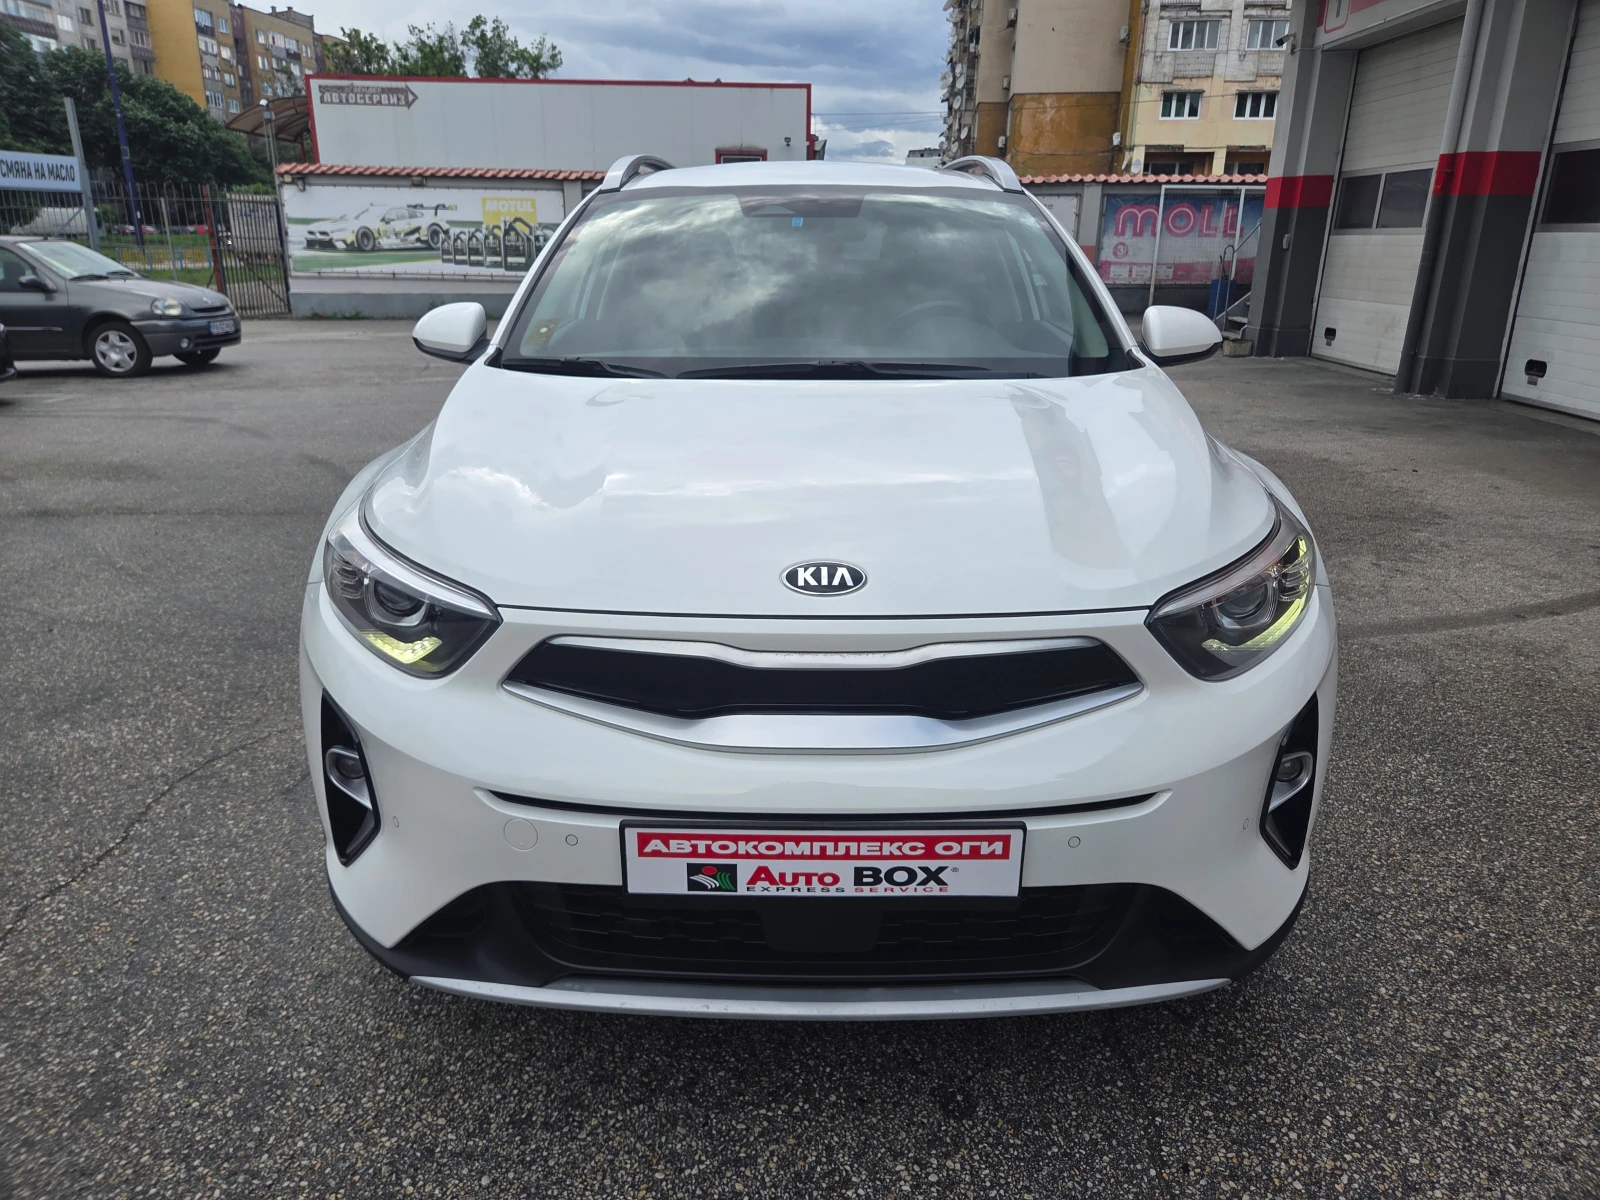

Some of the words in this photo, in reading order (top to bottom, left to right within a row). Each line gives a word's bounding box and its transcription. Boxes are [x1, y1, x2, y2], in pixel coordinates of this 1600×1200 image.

[323, 92, 406, 105] АВТОСЕРВИЗ
[0, 159, 33, 179] СМЯНА
[34, 162, 46, 180] НА
[47, 163, 76, 182] МАСЛО
[485, 199, 534, 212] MOTUL
[1113, 203, 1245, 238] MOLL
[796, 566, 854, 587] KIA
[643, 838, 927, 857] АВТОКОМПЛЕКС
[933, 840, 1004, 856] ОГИ
[746, 865, 841, 887] AUTO
